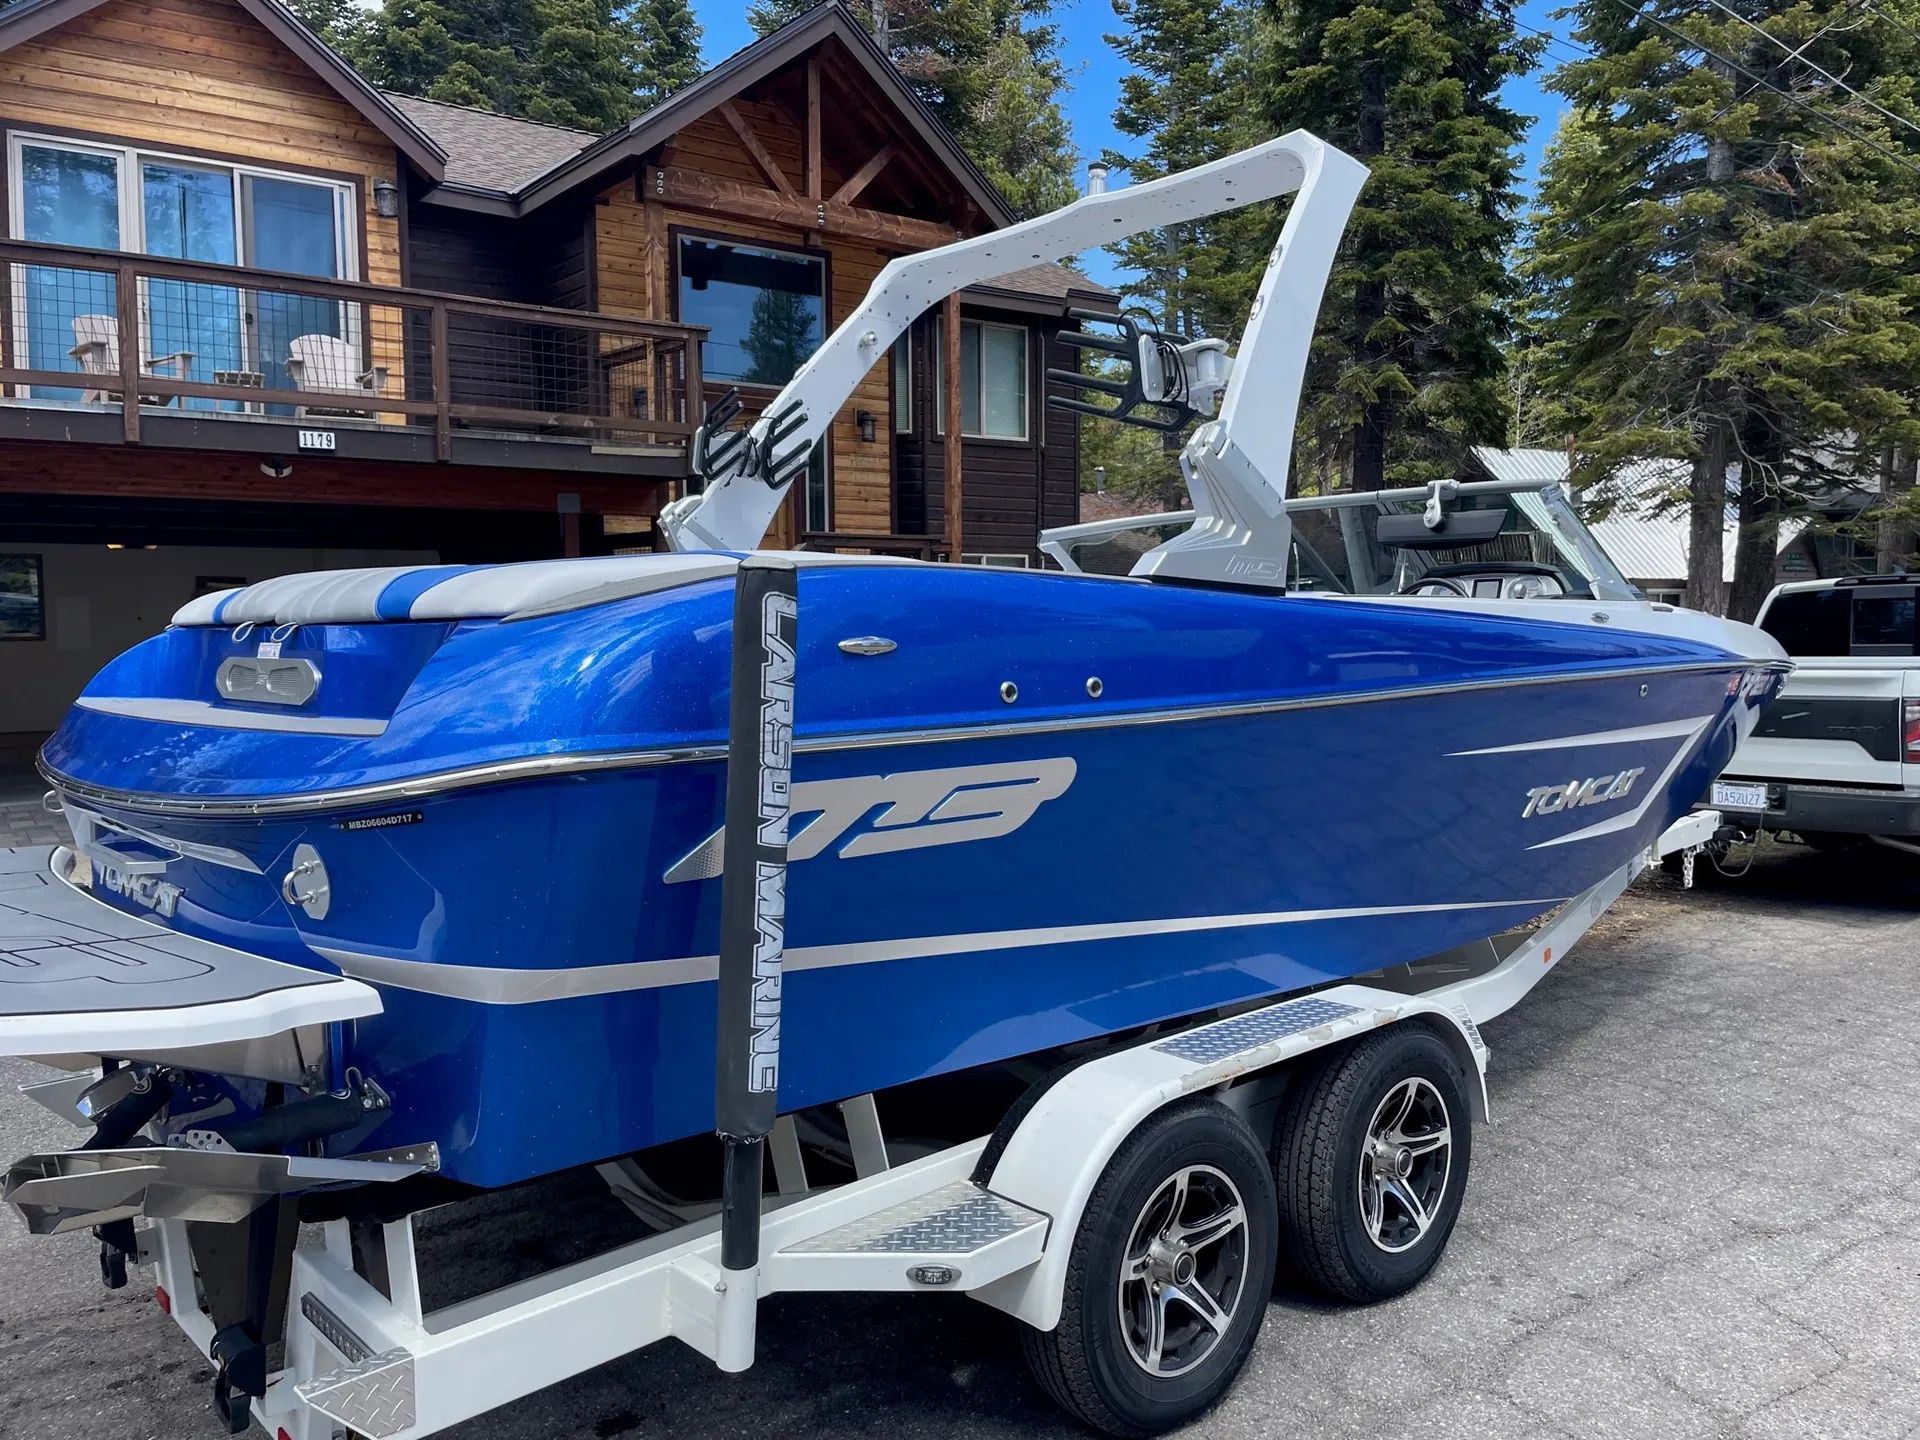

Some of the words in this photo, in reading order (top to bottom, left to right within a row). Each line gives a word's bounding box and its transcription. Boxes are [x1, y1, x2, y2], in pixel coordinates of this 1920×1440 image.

[302, 432, 332, 448] 1179
[757, 591, 797, 847] LARSON
[1521, 766, 1646, 819] TOMCAT
[1717, 791, 1761, 806] DA52U27
[748, 860, 787, 1094] MARINE
